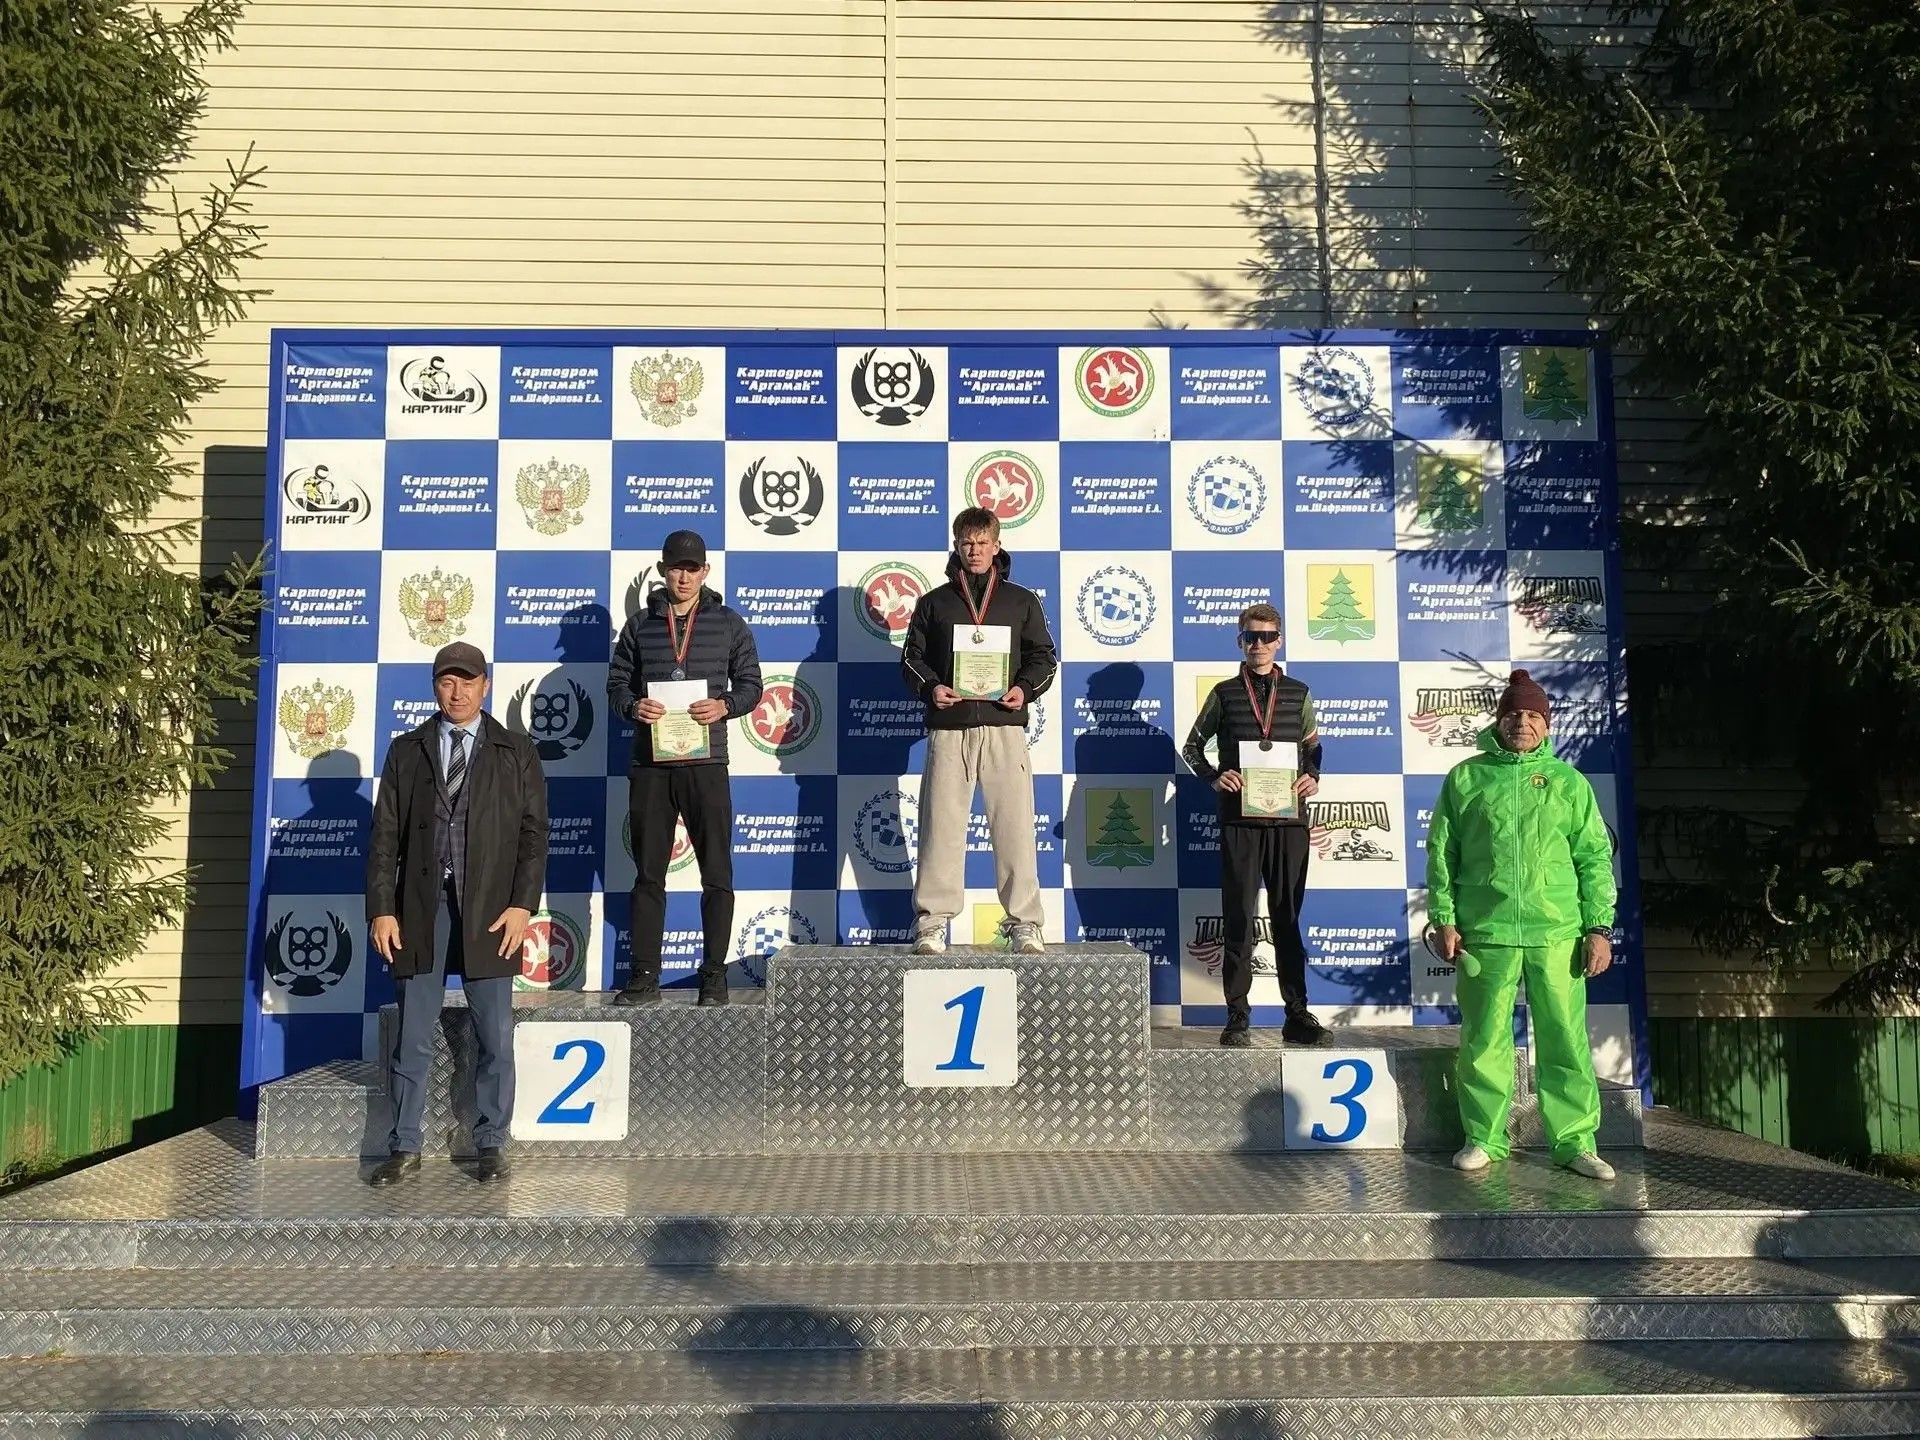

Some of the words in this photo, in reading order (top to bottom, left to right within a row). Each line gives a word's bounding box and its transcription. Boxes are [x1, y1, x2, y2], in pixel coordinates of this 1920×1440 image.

[287, 365, 373, 377] Картодром
[512, 366, 598, 378] Картодром
[736, 367, 823, 379] Картодром
[960, 368, 1045, 379] Картодром
[1181, 368, 1266, 379] Картодром
[402, 405, 466, 414] КАРТИНГ
[401, 474, 488, 487] Картодром
[626, 475, 714, 487] Картодром
[849, 476, 935, 488] Картодром
[1072, 476, 1158, 488] Картодром
[1296, 476, 1382, 487] Картодром
[286, 515, 350, 525] КАРТИНГ
[1210, 525, 1233, 533] ФАМС
[279, 587, 366, 599] Картодром
[507, 586, 596, 598] Картодром
[736, 587, 823, 599] Картодром
[1184, 586, 1270, 598] Картодром
[1408, 582, 1494, 594] Картодром
[742, 615, 808, 626] .Шафранова
[1183, 615, 1239, 625] им.Шафран
[849, 699, 926, 710] Картодро
[1074, 698, 1161, 710] Картодром
[1312, 700, 1389, 710] артодром
[853, 712, 924, 724] "Аргамак
[1315, 711, 1385, 723] Аргамак"
[1317, 727, 1374, 737] Шафранова
[735, 814, 823, 826] Картодром
[1308, 802, 1390, 832] TORNADO
[271, 818, 358, 830] Картодром
[1325, 820, 1371, 830] КАРТИНГ
[1308, 926, 1397, 939] Картодром
[936, 986, 986, 1072] 1
[536, 1039, 606, 1124] 2
[1310, 1058, 1374, 1144] 3
